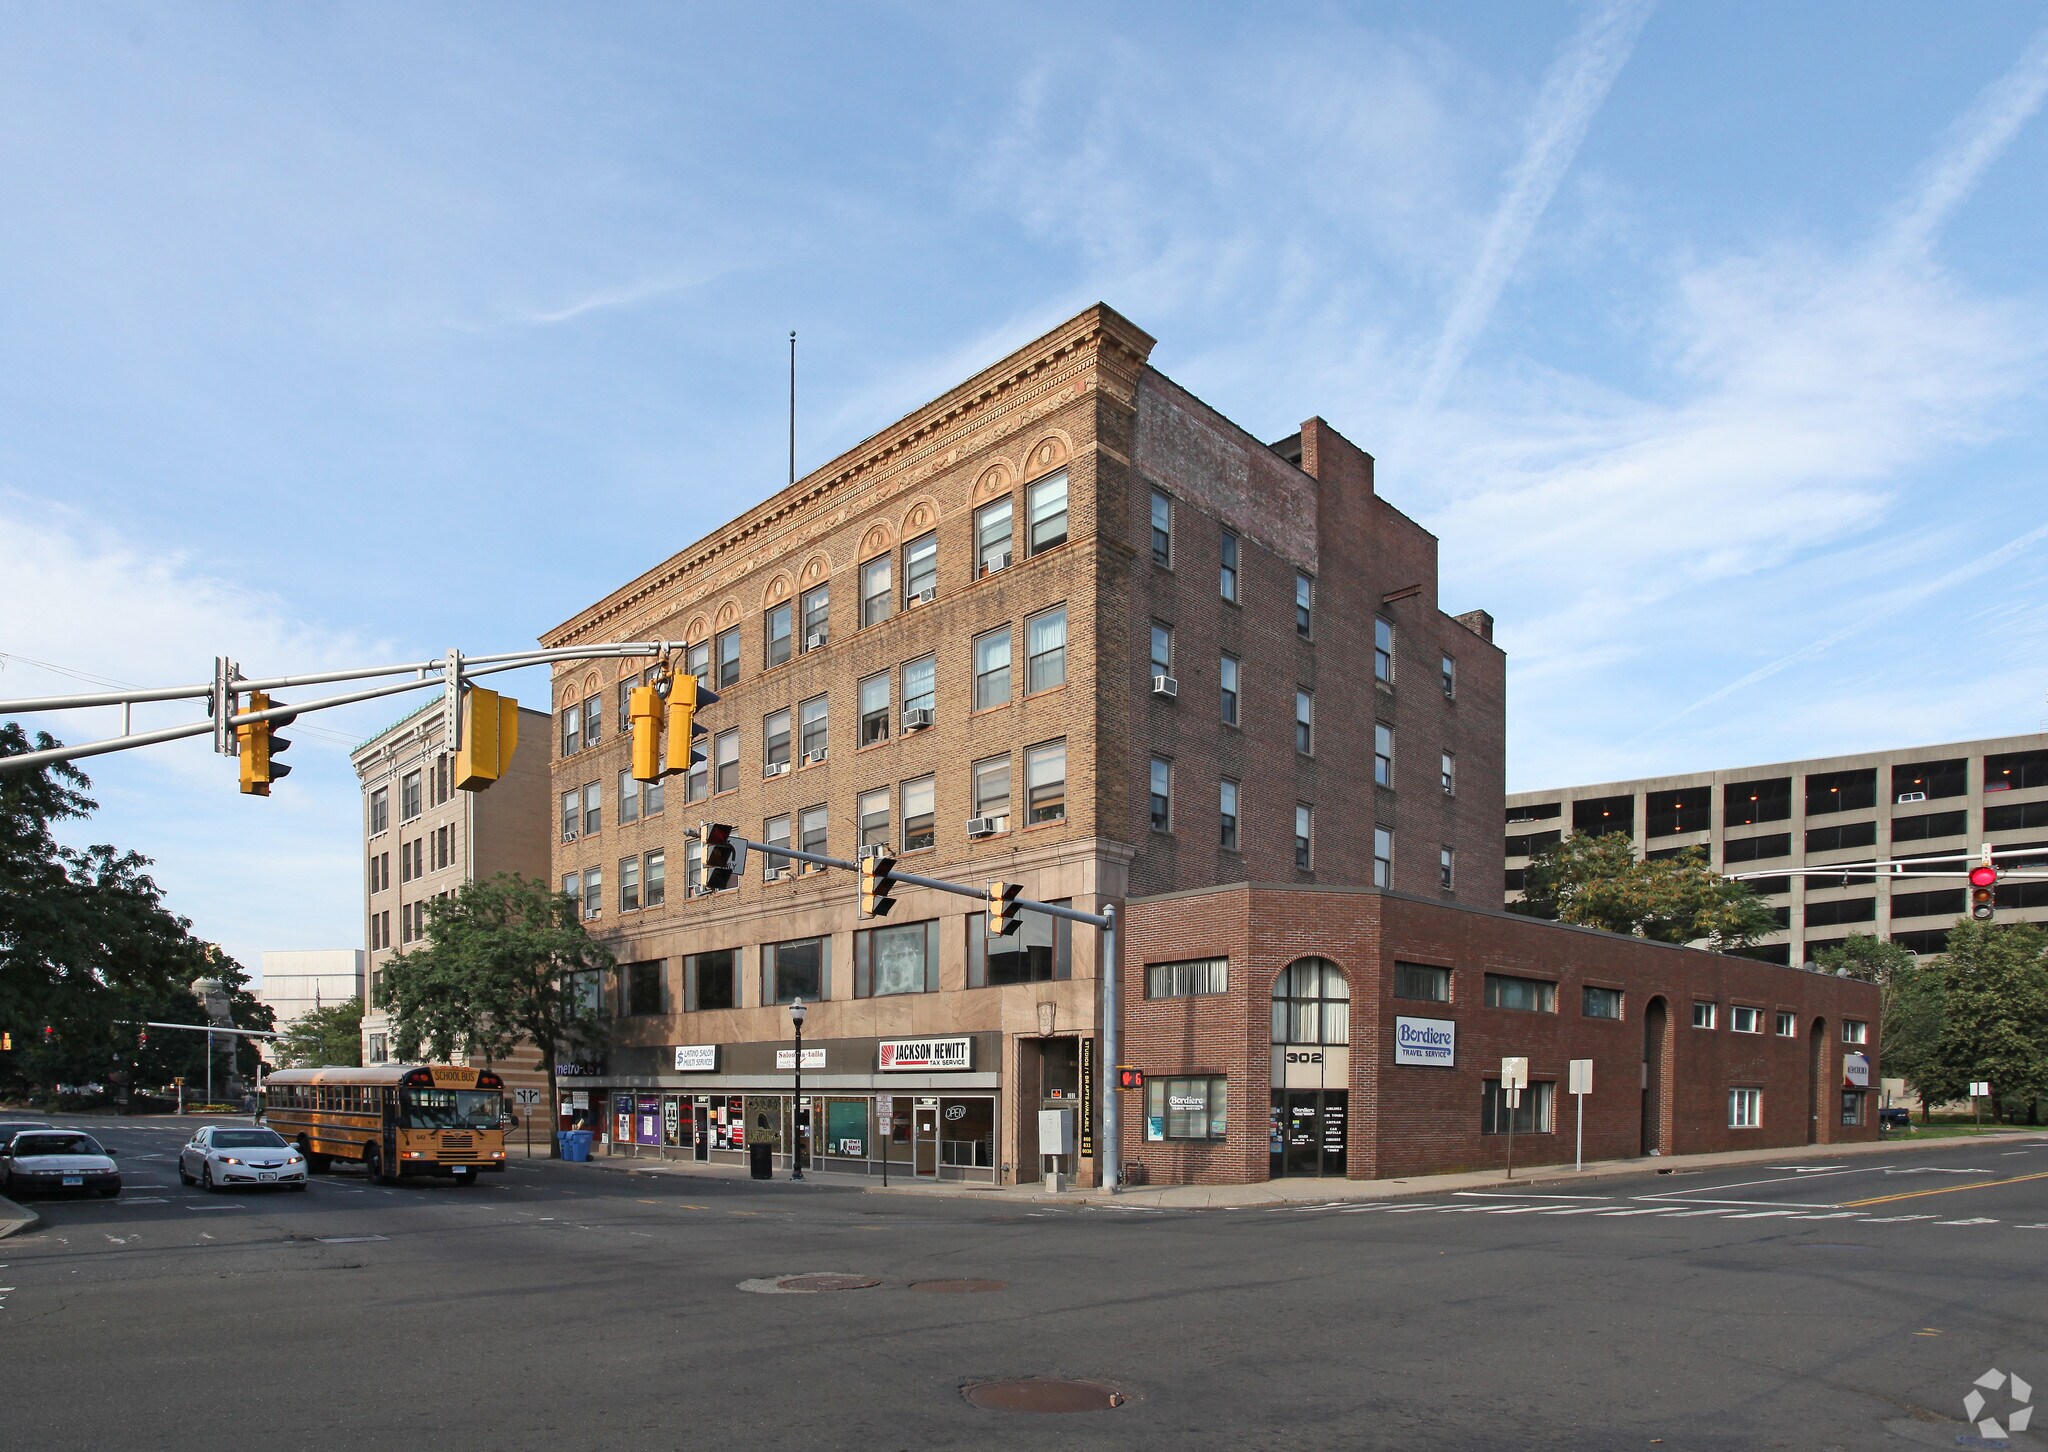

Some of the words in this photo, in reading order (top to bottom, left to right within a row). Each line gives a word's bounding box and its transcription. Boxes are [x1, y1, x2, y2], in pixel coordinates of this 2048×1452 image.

[1398, 1023, 1451, 1045] Bordiere
[684, 1050, 699, 1058] LATINO
[700, 1049, 713, 1057] SALON
[896, 1044, 931, 1060] JACKSON
[934, 1042, 965, 1059] HEWITT
[1402, 1049, 1422, 1057] TRAVEL
[1425, 1050, 1446, 1058] SERVICE
[696, 1058, 713, 1066] SERVICES
[1286, 1052, 1322, 1063] 302
[434, 1071, 460, 1081] SCHOOL
[461, 1072, 475, 1081] BUS
[1135, 1072, 1142, 1085] 6
[1170, 1096, 1203, 1105] Bordiere
[945, 1107, 964, 1118] OPEN
